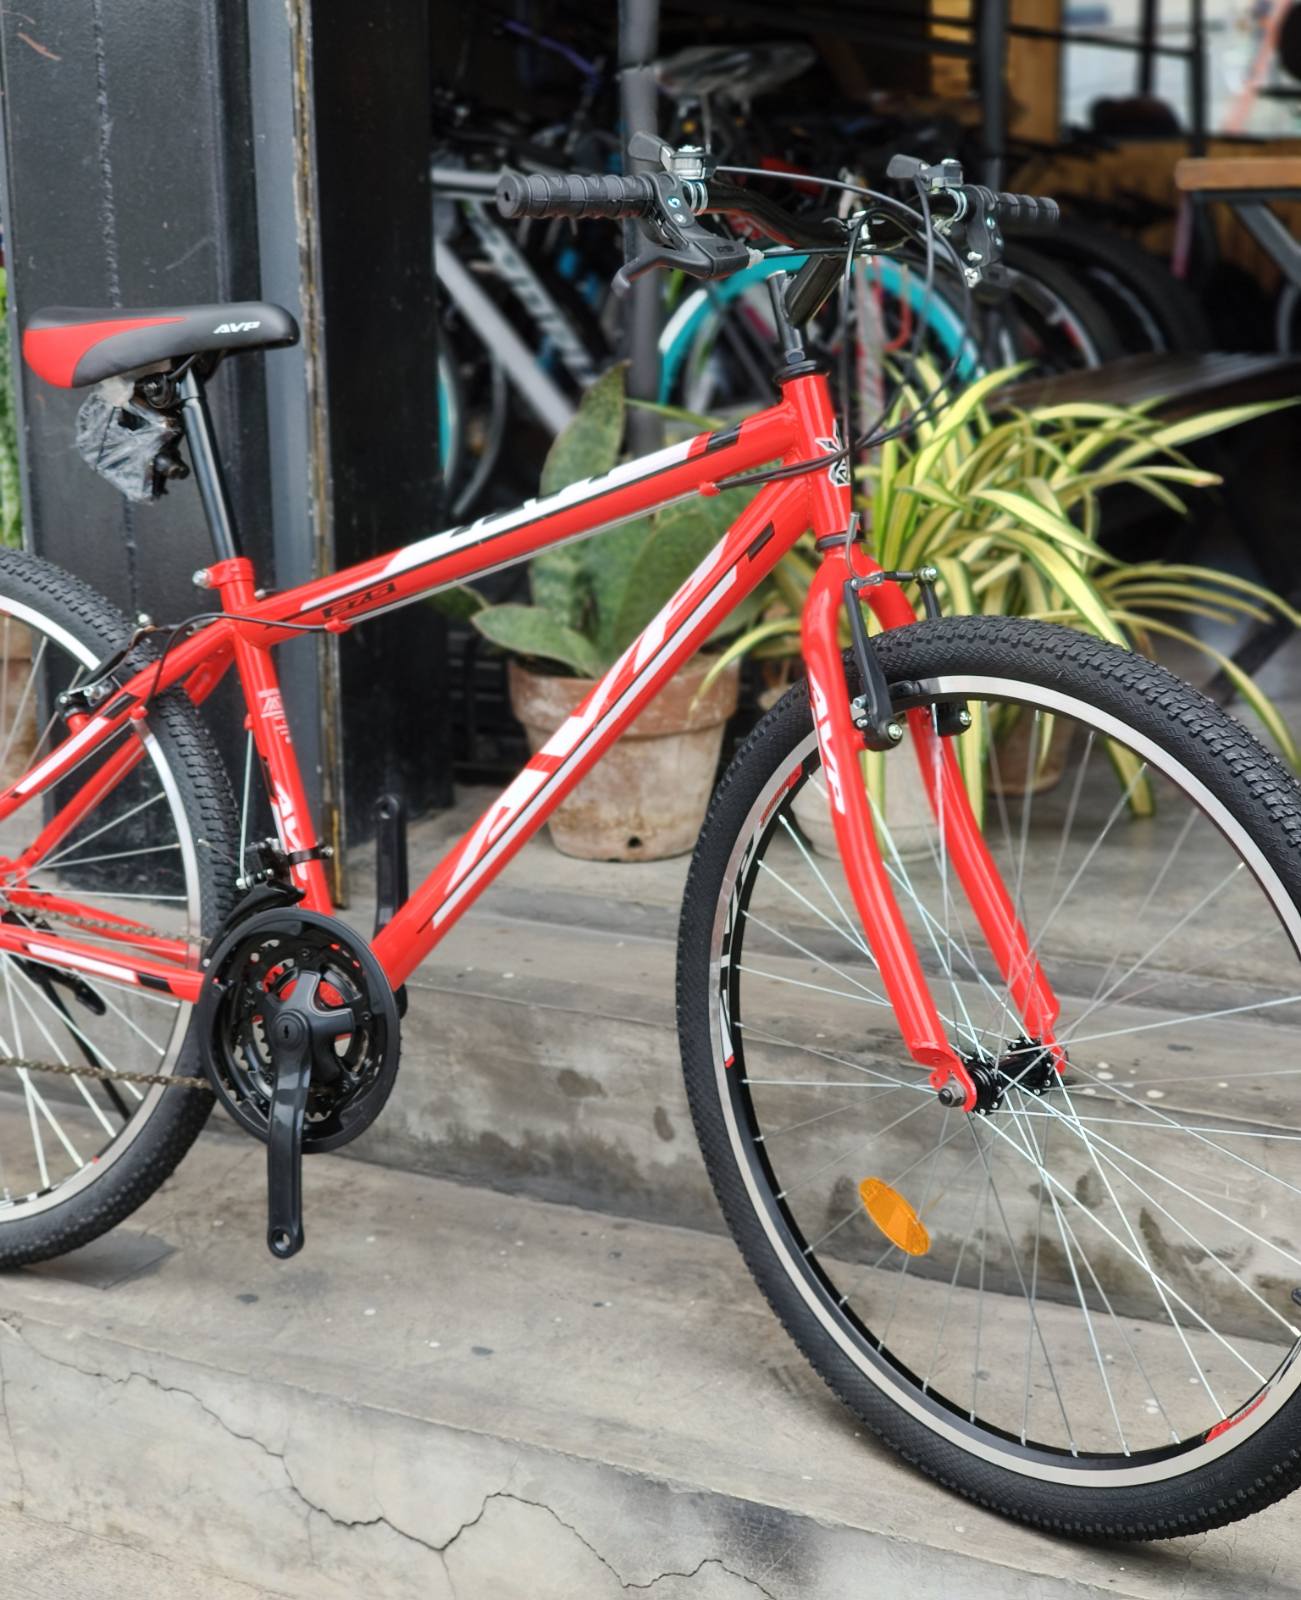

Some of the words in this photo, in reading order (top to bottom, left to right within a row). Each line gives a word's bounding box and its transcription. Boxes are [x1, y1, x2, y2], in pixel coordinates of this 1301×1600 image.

[213, 321, 260, 334] AVP
[444, 532, 730, 895] AVP
[808, 667, 846, 815] AVP
